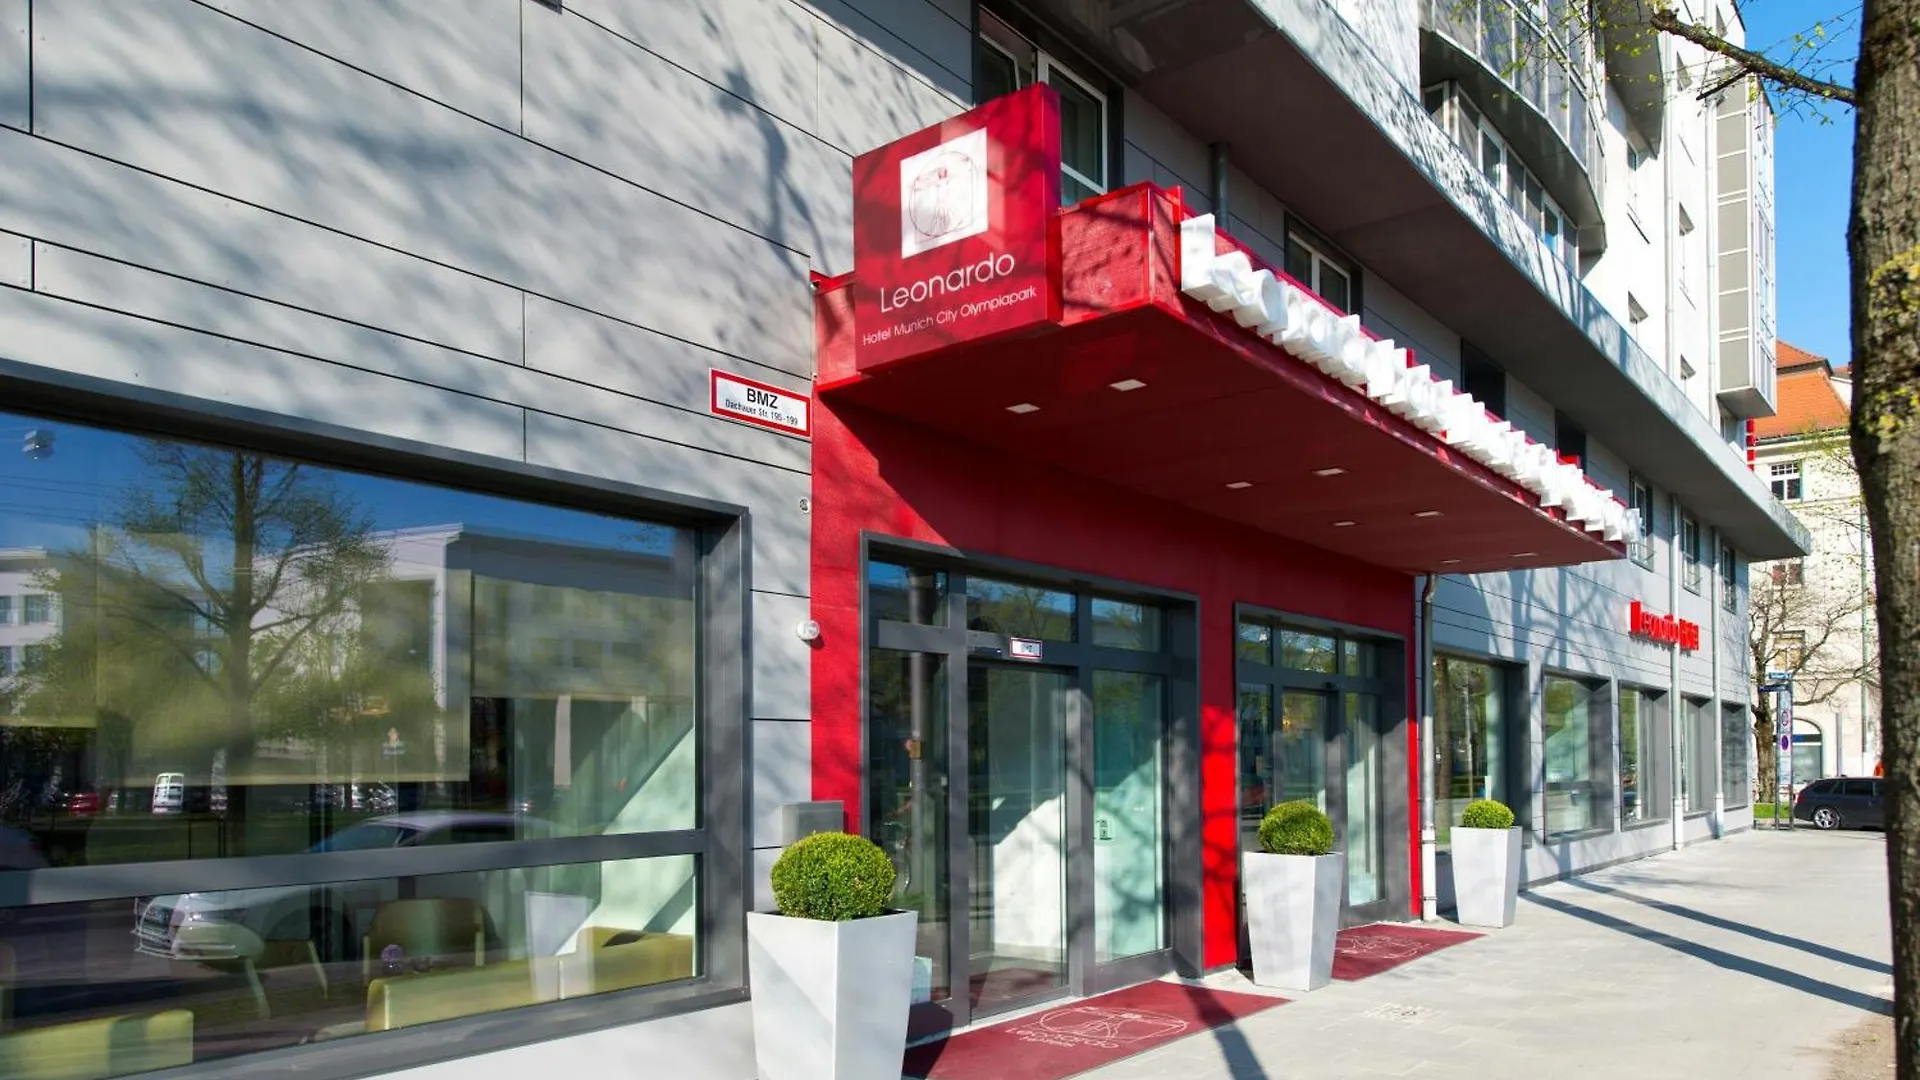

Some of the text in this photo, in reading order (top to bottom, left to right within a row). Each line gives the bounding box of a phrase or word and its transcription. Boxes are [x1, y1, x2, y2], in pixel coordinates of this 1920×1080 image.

[881, 252, 1015, 313] Leonardo
[863, 286, 1037, 346] Hotel Munich City Olympiapark
[725, 399, 756, 414] Dachauer
[747, 388, 778, 409] BMZ
